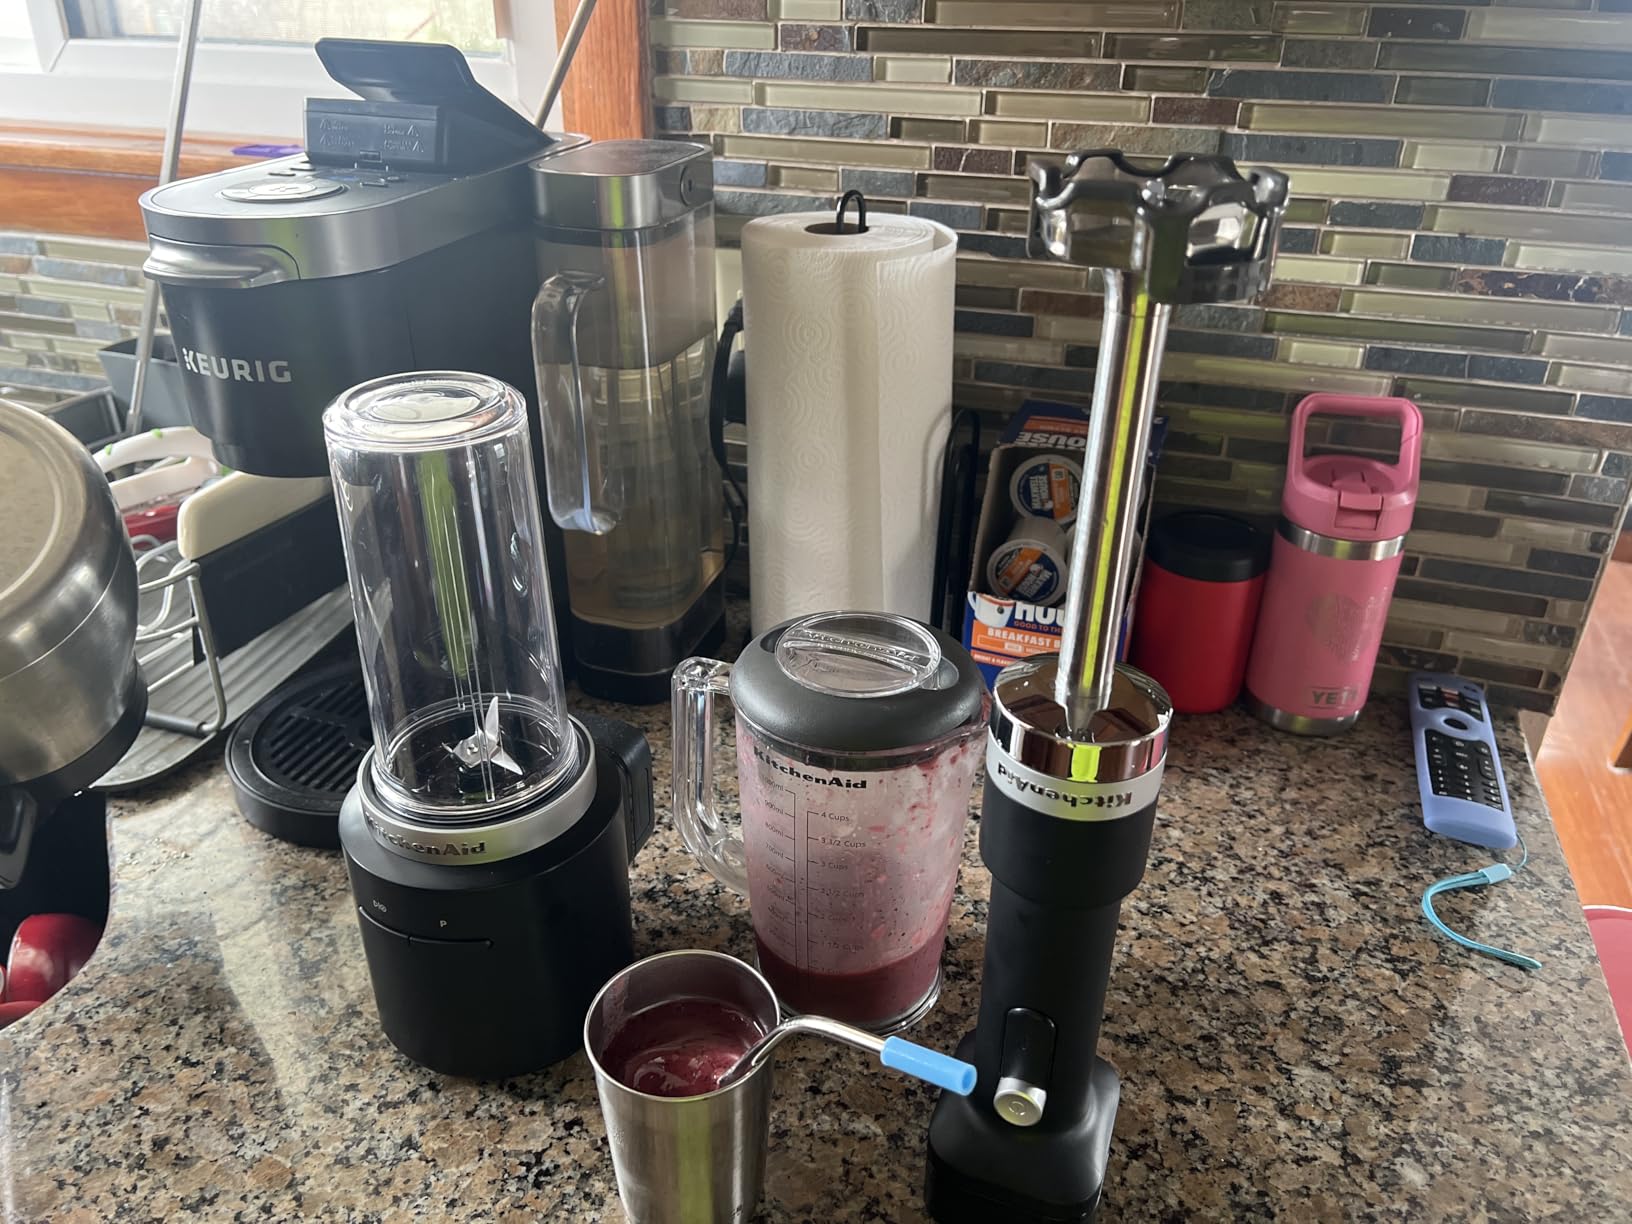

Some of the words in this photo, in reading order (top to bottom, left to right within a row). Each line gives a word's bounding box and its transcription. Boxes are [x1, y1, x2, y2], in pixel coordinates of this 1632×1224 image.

[182, 347, 292, 383] KEURIG
[1015, 431, 1087, 448] OUSE
[1014, 621, 1037, 630] GOOD
[987, 627, 1052, 648] BREAKFAST
[1311, 688, 1358, 705] YETI
[753, 746, 867, 789] KitchenAid
[997, 761, 1133, 808] KitchenAid
[828, 813, 850, 822] Cups
[364, 811, 487, 856] KitchenAid
[830, 839, 841, 847] 1/2
[843, 840, 867, 849] Cups
[828, 862, 849, 871] Cups
[439, 920, 447, 928] P
